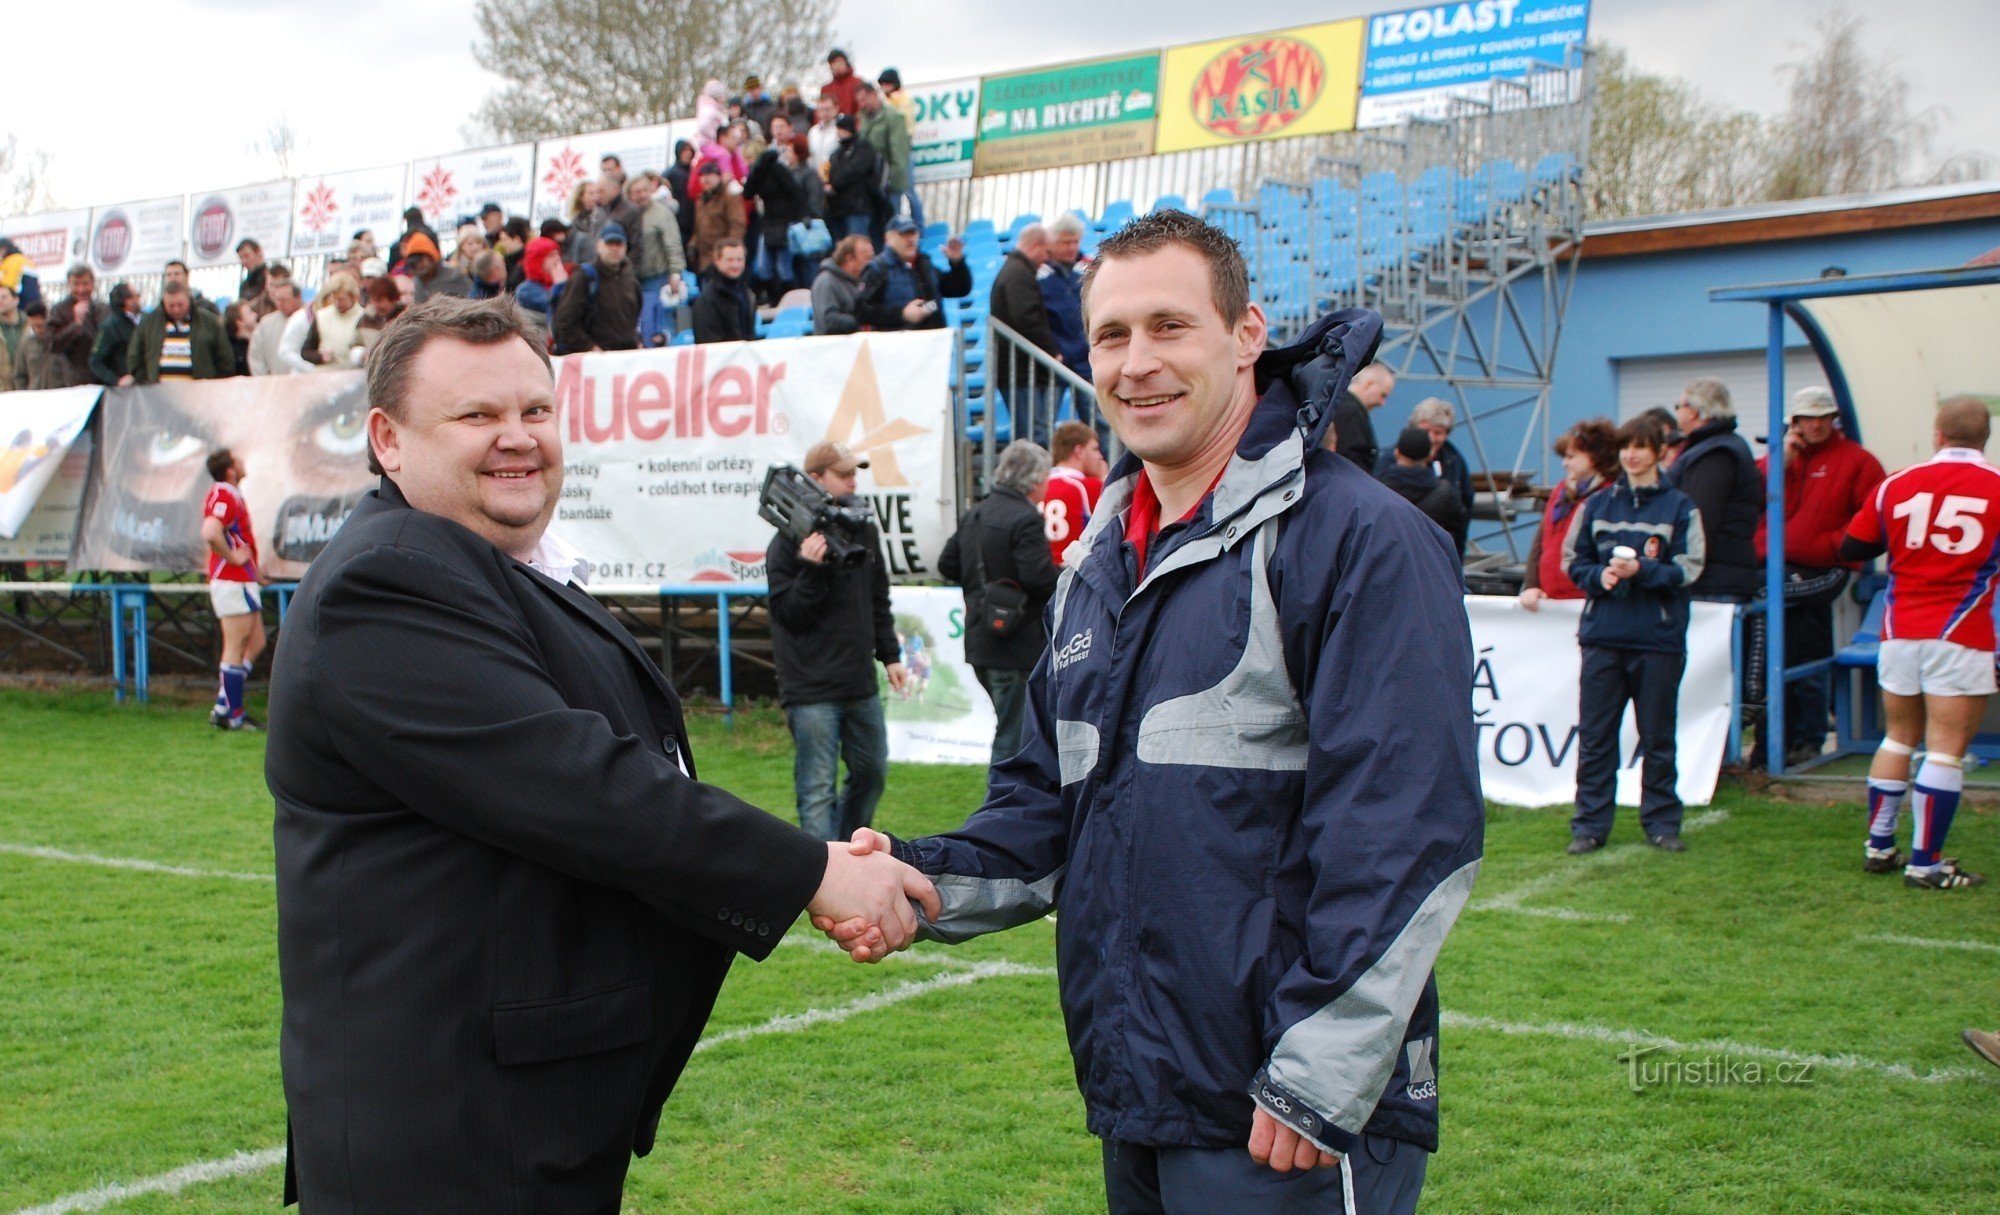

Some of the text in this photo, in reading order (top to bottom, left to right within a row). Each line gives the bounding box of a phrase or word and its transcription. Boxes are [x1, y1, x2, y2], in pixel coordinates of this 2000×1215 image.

[1370, 0, 1521, 47] IZOLAST
[1011, 108, 1037, 132] NA
[1042, 90, 1122, 130] RYCHTĚ
[1210, 87, 1301, 121] KASIA
[649, 459, 703, 474] kolenní
[707, 456, 755, 475] ortézy
[649, 481, 707, 496] cold/hot
[712, 480, 763, 497] terapie
[559, 506, 613, 520] bandáže
[1037, 499, 1070, 541] 8
[1893, 492, 1989, 555] 15
[730, 560, 769, 581] Spor
[1262, 1086, 1292, 1114] ooGa
[1407, 1080, 1437, 1100] KooGa
